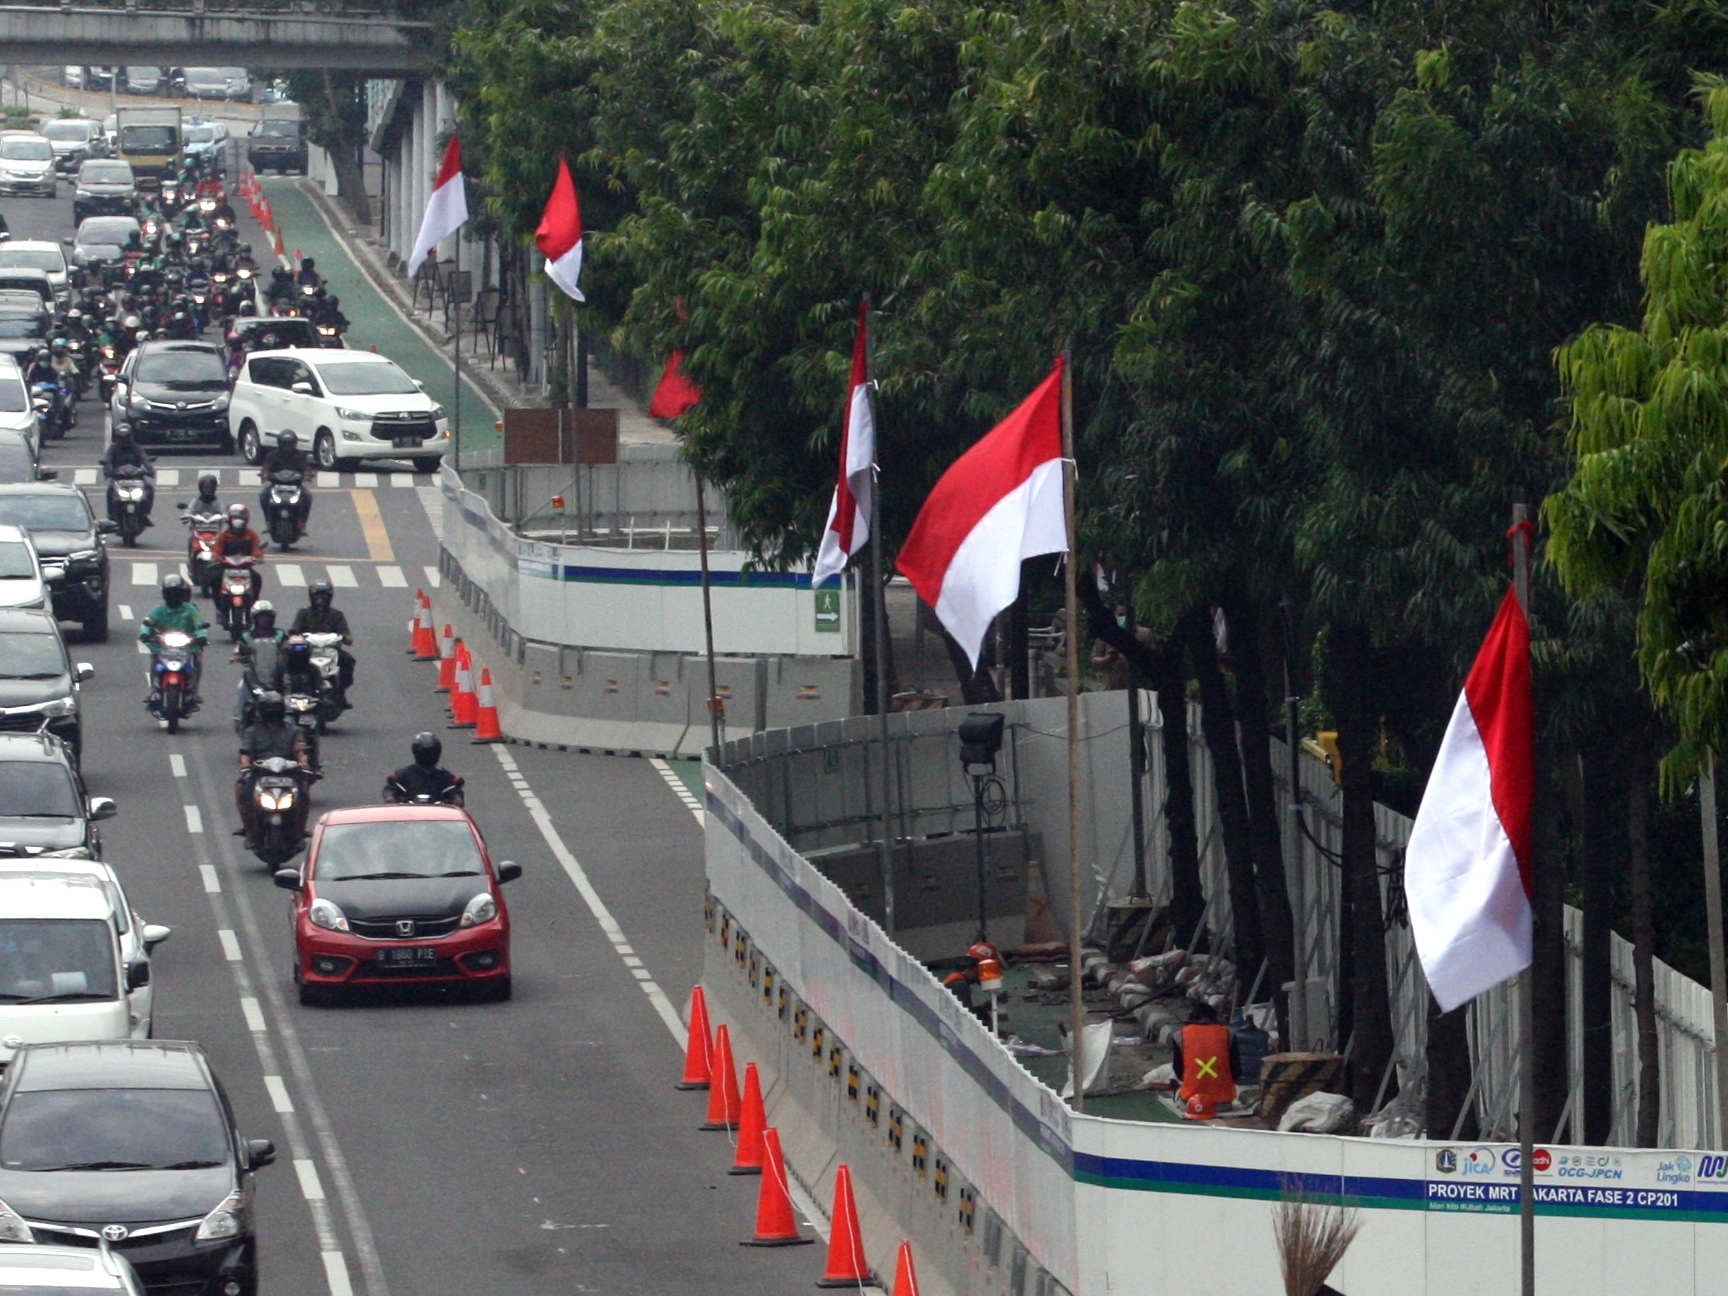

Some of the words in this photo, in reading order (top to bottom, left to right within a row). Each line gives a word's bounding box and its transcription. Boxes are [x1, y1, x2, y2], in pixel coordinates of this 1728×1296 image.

[1558, 1167, 1622, 1179] OCG-JPCN
[1657, 1161, 1675, 1173] Jak
[1657, 1172, 1690, 1185] Lingko
[1429, 1183, 1485, 1199] PROYEK
[1488, 1186, 1518, 1200] MRT
[1533, 1188, 1583, 1202] AKARTA
[1587, 1189, 1623, 1204] FASE
[1626, 1191, 1634, 1205] 2
[1637, 1192, 1678, 1207] CP201
